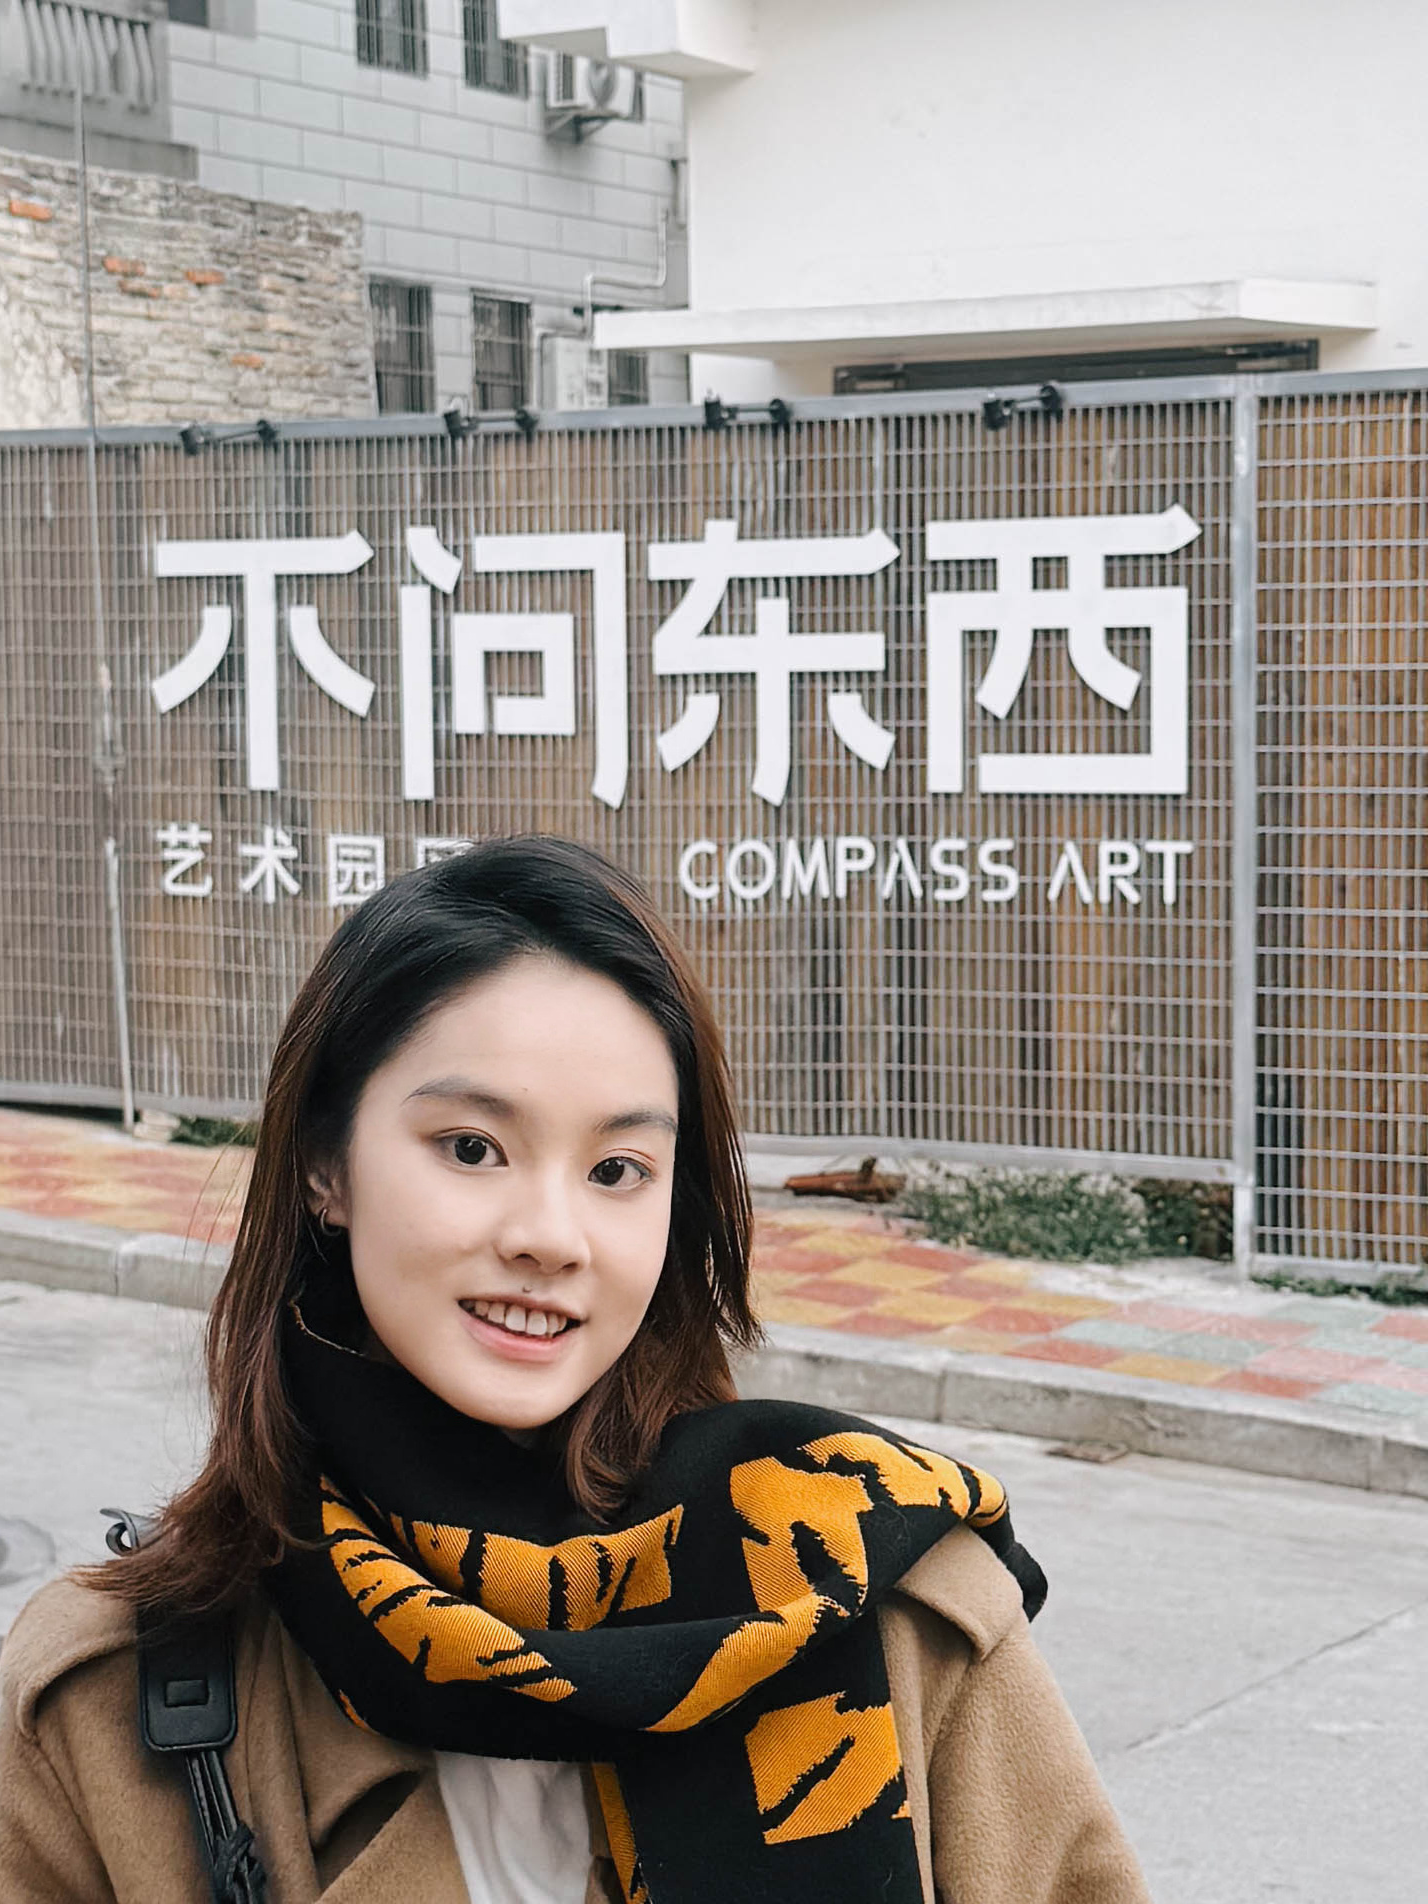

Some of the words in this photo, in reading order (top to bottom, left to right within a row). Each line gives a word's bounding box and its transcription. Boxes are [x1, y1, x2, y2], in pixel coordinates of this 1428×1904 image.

[151, 503, 1203, 809] 不问东西
[678, 837, 1021, 902] COMPASS
[1047, 839, 1195, 905] ART
